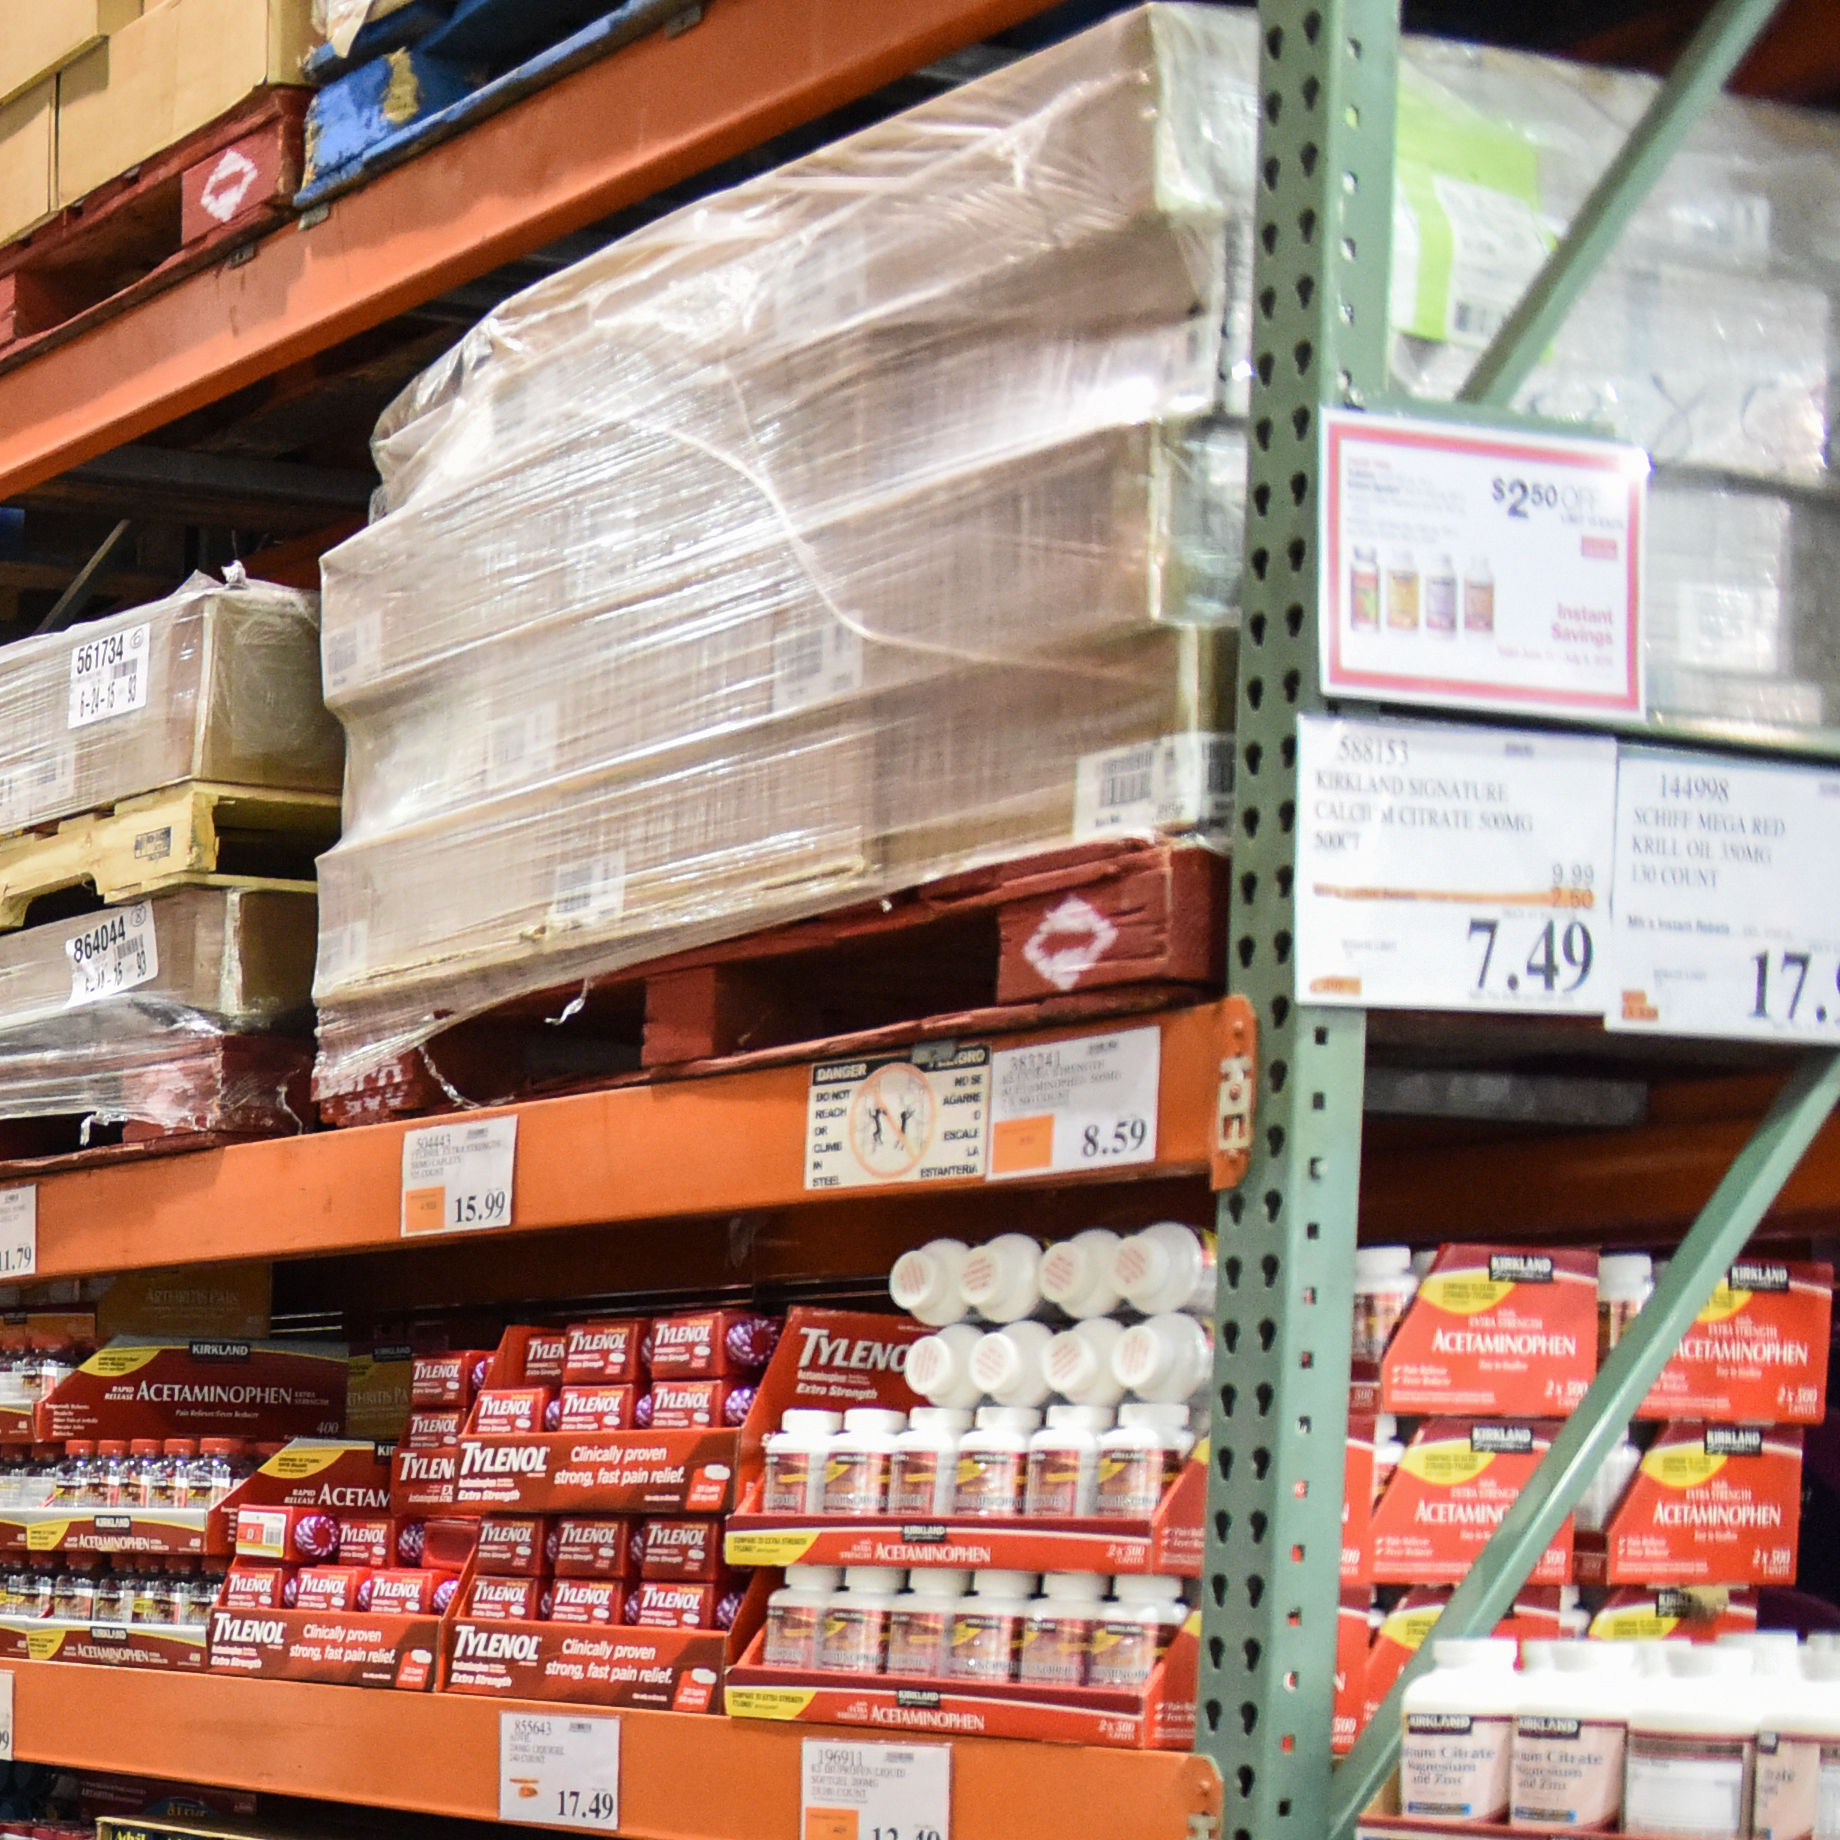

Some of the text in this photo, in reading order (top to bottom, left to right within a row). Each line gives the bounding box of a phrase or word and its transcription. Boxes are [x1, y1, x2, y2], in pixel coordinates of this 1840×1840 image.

[1557, 602, 1613, 625] Instant
[1551, 623, 1613, 648] Savings
[77, 634, 123, 674] 561734
[1338, 735, 1409, 765] 588153
[1316, 770, 1508, 802] KIRKLAND SIGNATURE
[1660, 773, 1729, 802] 144998
[1314, 801, 1394, 824] CALCIM
[1399, 806, 1473, 830] CITRATE
[1632, 806, 1786, 837] SCHIFF MEGA RED
[1632, 836, 1678, 858] KRILL
[1687, 840, 1711, 858] OIL
[1552, 864, 1594, 884] 9.99
[1660, 868, 1718, 888] COUNT
[74, 915, 125, 963] 864044
[1467, 917, 1594, 993] 7.49
[816, 1064, 868, 1082] DANGER
[831, 1089, 851, 1101] NOT
[943, 1092, 982, 1106] AGARRE
[815, 1107, 847, 1119] REACH
[814, 1126, 828, 1137] OR
[944, 1128, 980, 1140] ESCALE
[1081, 1118, 1148, 1158] 8.59
[812, 1176, 840, 1187] STEEL
[920, 1164, 978, 1178] ESTANTERIA
[455, 1191, 506, 1222] 15.99
[1491, 1255, 1553, 1274] KIRKLAND
[1731, 1266, 1788, 1283] KIRKLAND
[655, 1321, 712, 1345] TYLENOL
[1431, 1329, 1577, 1357] ACETAMINOPHEN
[192, 1344, 248, 1356] KIRKLAND
[136, 1380, 293, 1404] ACETAMINOPHEN
[796, 1383, 878, 1401] Extra Strength
[316, 1421, 339, 1435] 400
[1706, 1429, 1762, 1447] KIRKLAND
[461, 1442, 550, 1476] TYLENOL
[571, 1445, 667, 1465] Clinically proven
[554, 1466, 685, 1487] strong, fast pain relief.
[284, 1495, 315, 1505] RELEASE
[292, 1489, 316, 1498] RAPID
[457, 1490, 520, 1502] Extra Strength
[1652, 1502, 1781, 1527] ACETAMINOPHEN
[903, 1525, 947, 1538] KIRKLAND
[874, 1542, 991, 1563] ACETAMINOPHEN
[212, 1613, 287, 1644] TYLENOL
[454, 1625, 542, 1660] TYLENOL
[514, 1719, 553, 1737] 855643
[870, 1704, 986, 1732] ACETAMINOPHEN
[816, 1749, 865, 1766] 196911
[555, 1789, 614, 1821] 17.49
